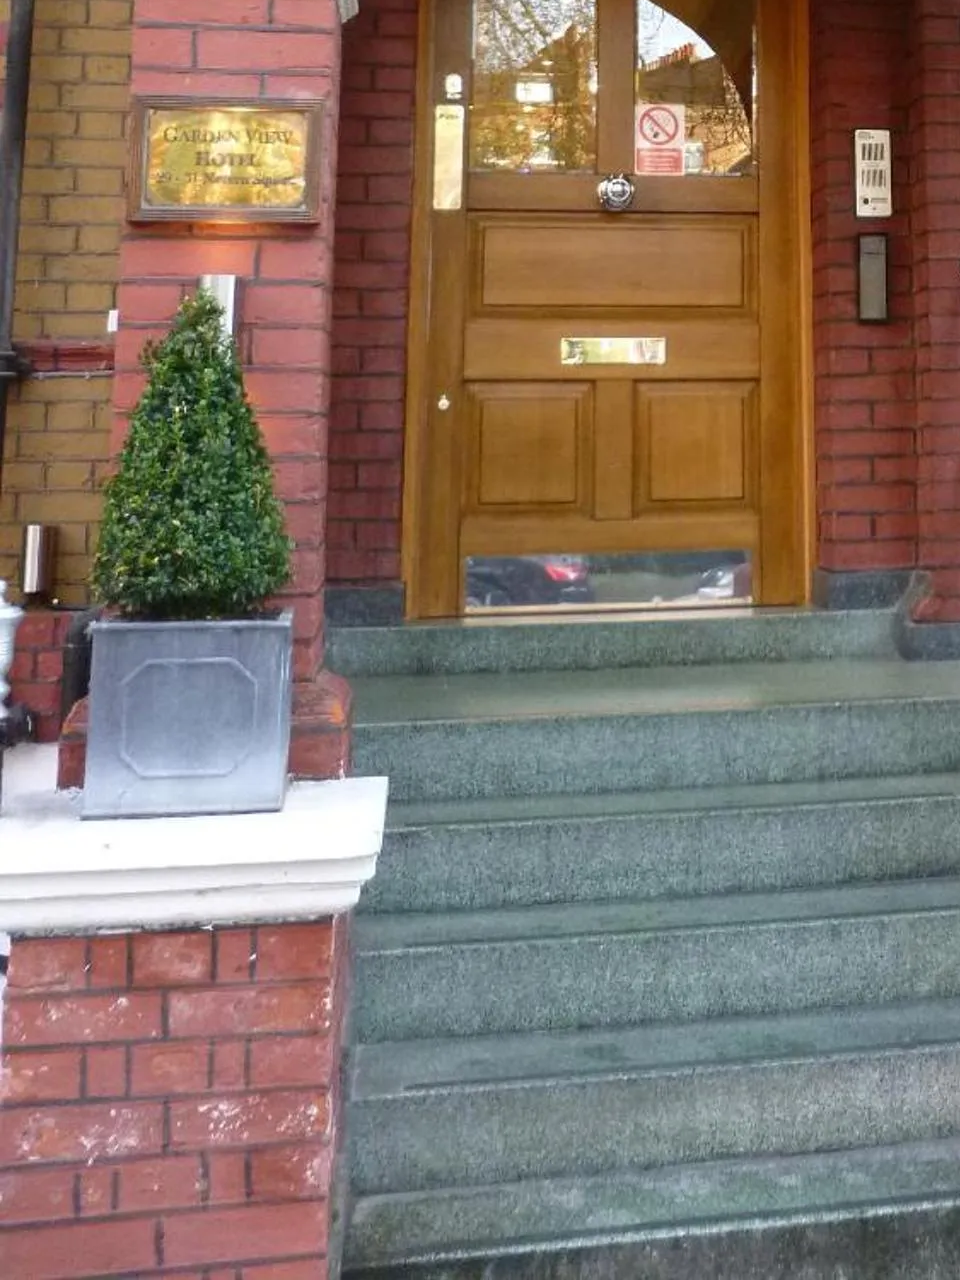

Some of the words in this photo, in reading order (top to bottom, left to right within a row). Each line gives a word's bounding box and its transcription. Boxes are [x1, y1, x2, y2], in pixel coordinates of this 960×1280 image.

[163, 127, 240, 143] GARDEN
[246, 128, 293, 144] VIEW
[195, 152, 259, 166] HOTEL
